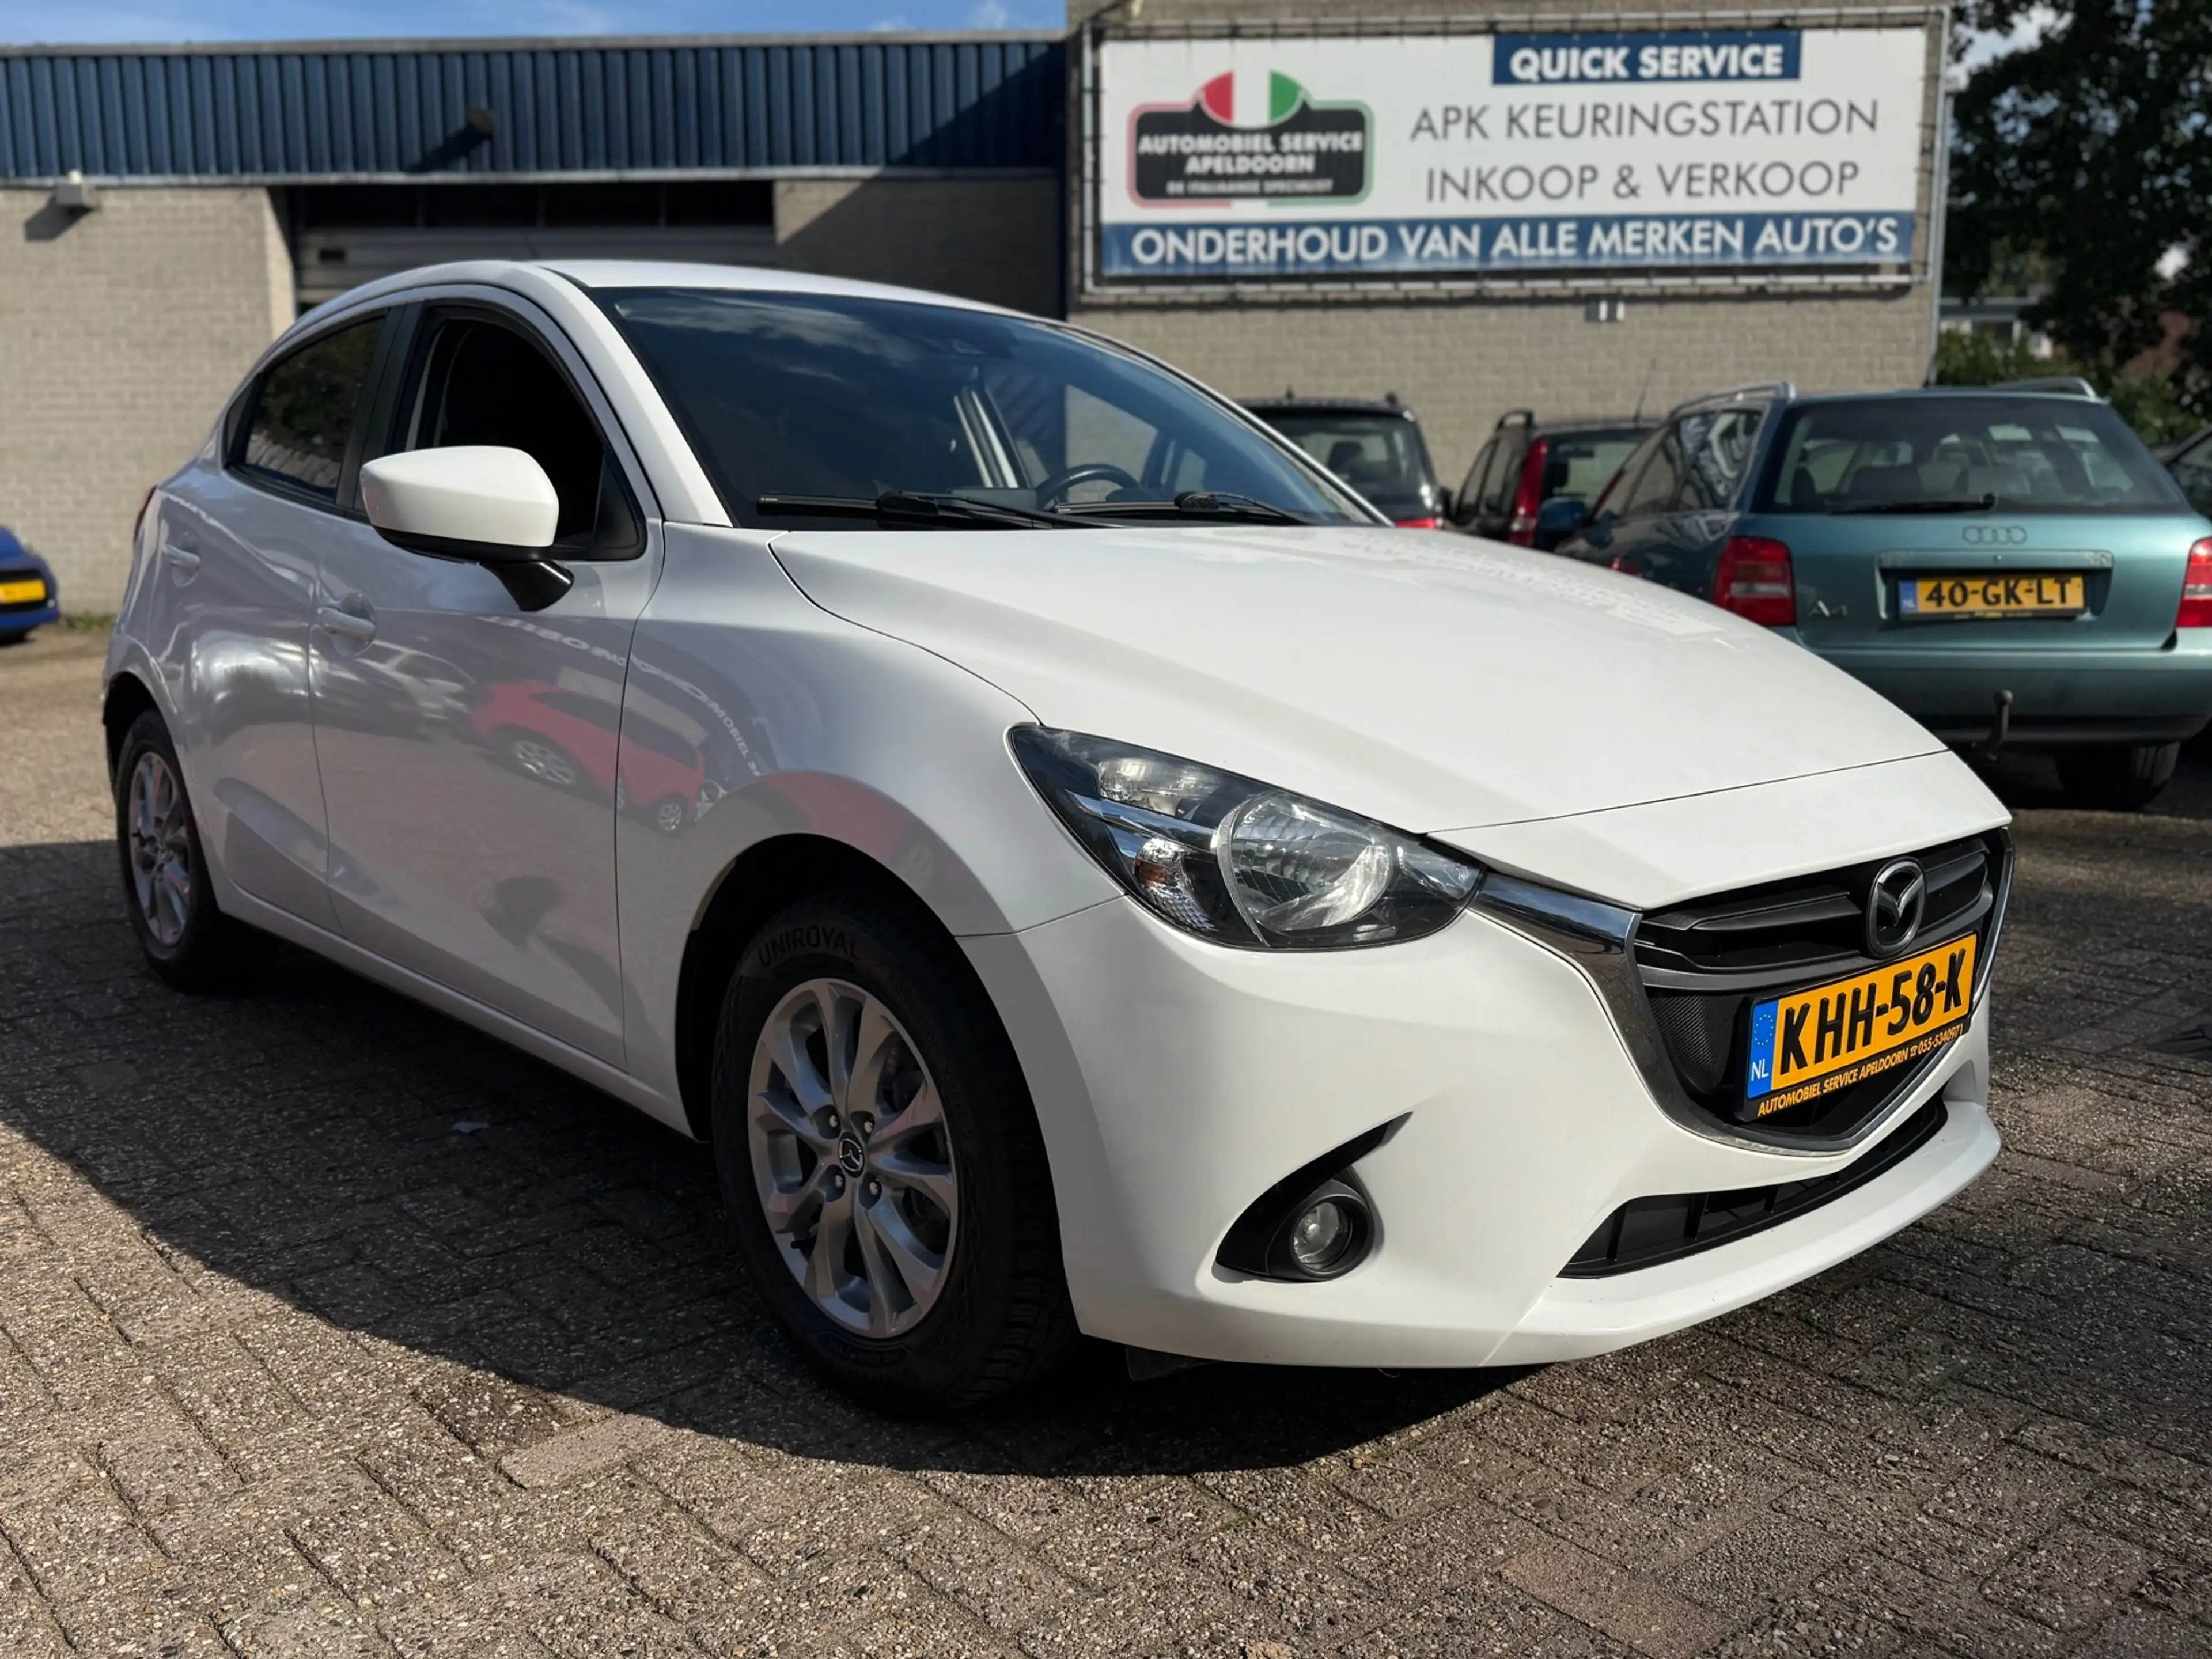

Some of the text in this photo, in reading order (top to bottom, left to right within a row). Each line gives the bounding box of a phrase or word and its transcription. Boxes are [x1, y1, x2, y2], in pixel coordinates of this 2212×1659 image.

[1509, 44, 1785, 82] QUICK SERVICE
[1410, 99, 1878, 141] APK KEURINGSTATION
[1137, 131, 1364, 154] AUTOMOBIEL SERVICE
[1184, 154, 1316, 175] APELDOORN
[1426, 160, 1860, 203] INKOOP & VERKOOP
[1131, 217, 1899, 265] ONDERHOUD VAN ALLE MERKEN AUTO'S
[1925, 577, 2072, 608] 40-GK-LT
[757, 925, 862, 967] UNIROYAL
[1779, 948, 1967, 1076] KHH-58-K
[1751, 1061, 1770, 1082] NL
[1757, 1082, 1821, 1118] AUTOMOBIEL
[1823, 1067, 1858, 1094] SERVICE
[1859, 1048, 1908, 1080] APELDOORN
